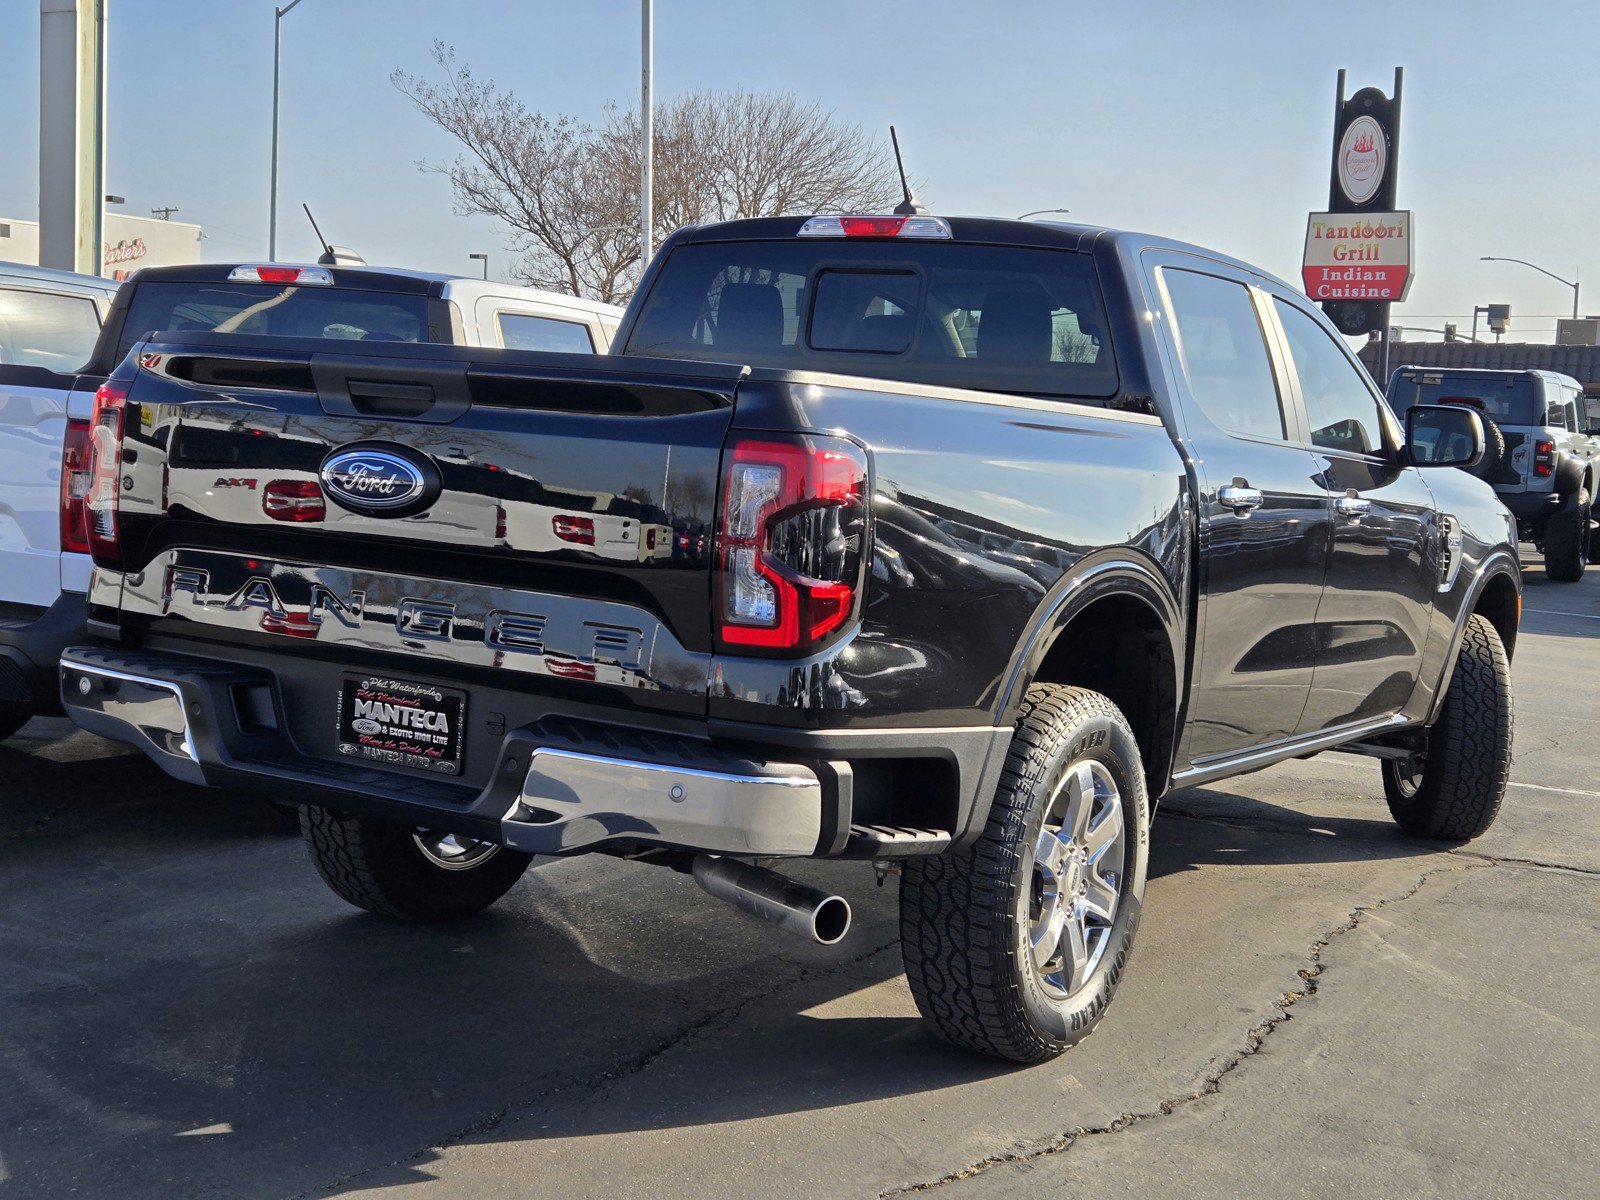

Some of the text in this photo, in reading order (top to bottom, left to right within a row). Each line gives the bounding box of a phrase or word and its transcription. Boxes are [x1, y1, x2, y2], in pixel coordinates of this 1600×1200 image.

[1312, 219, 1404, 239] Tandoori
[1333, 243, 1380, 261] Grill
[1321, 267, 1387, 281] Indian
[1317, 284, 1391, 298] Cuisine
[343, 462, 397, 493] Ford
[161, 564, 644, 670] RANGER
[370, 677, 388, 689] Phil
[354, 698, 449, 734] MANTECA
[389, 727, 413, 739] EXOTIC
[414, 731, 431, 742] HIGH
[432, 735, 448, 746] LINE
[362, 746, 404, 763] MANTECA
